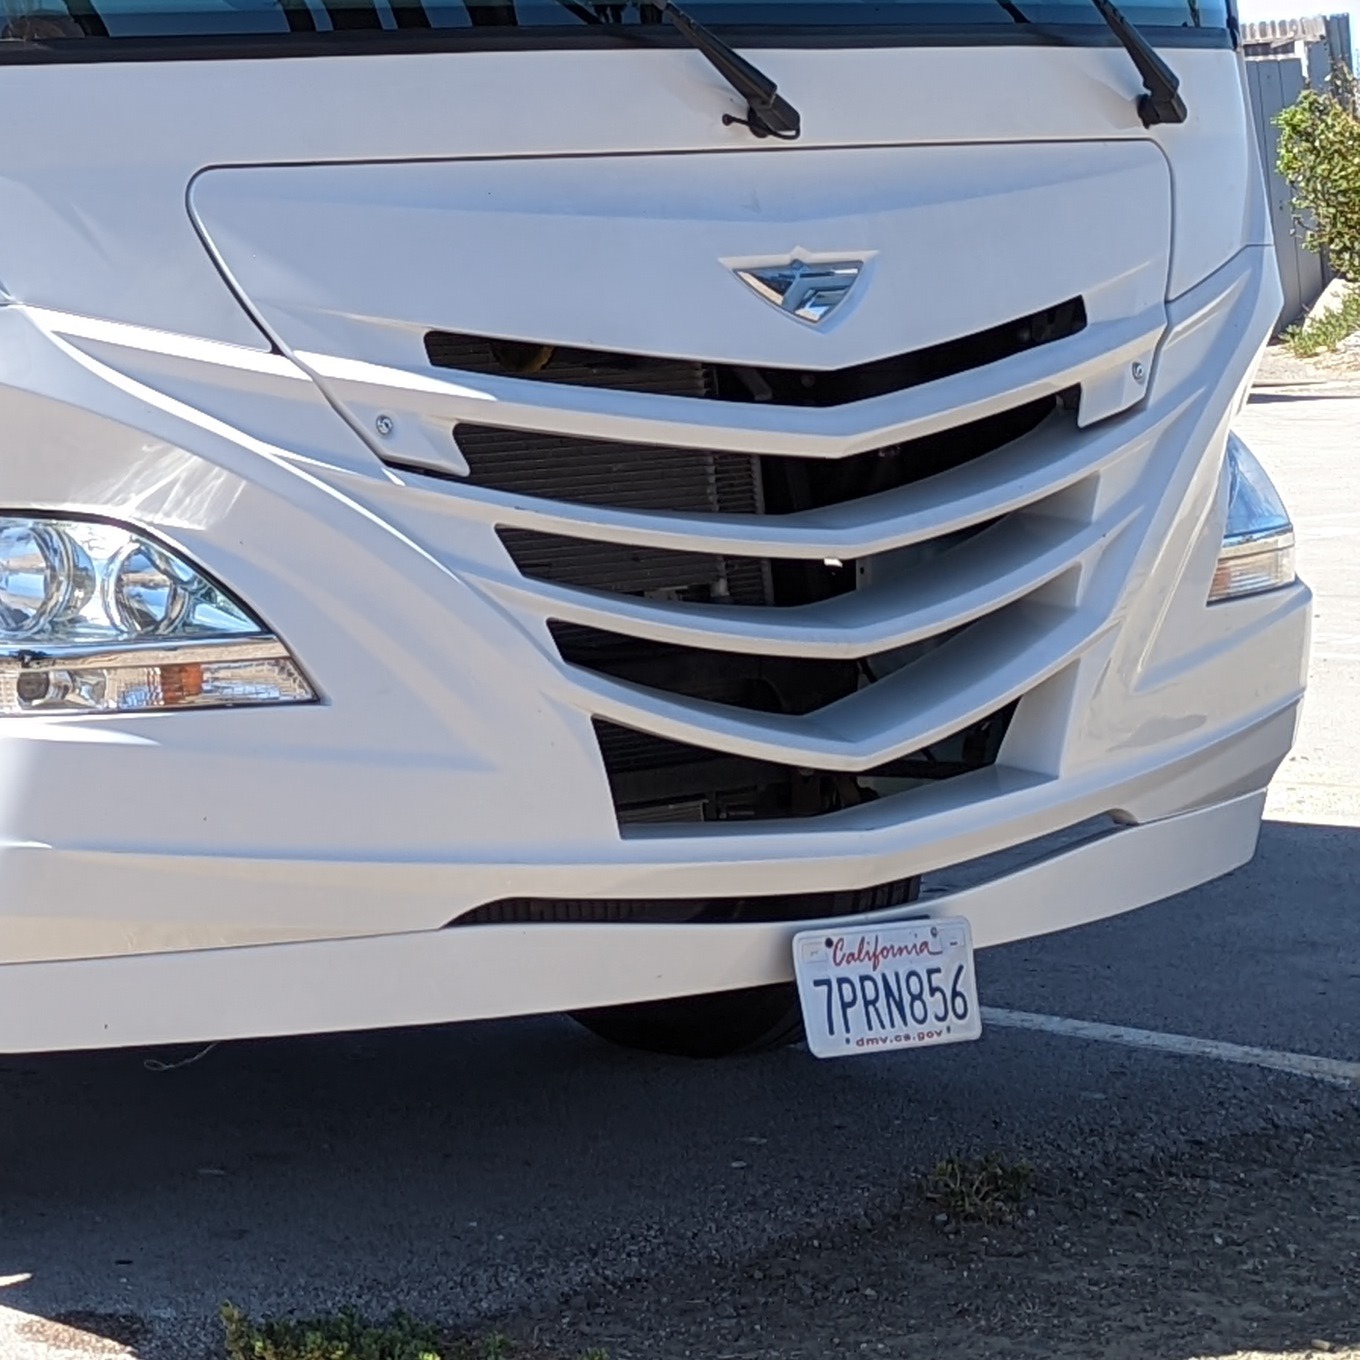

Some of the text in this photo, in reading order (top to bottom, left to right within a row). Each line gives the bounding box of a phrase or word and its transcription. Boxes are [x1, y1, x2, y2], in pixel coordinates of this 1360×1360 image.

[832, 934, 943, 972] California
[813, 964, 969, 1036] 7PRN856
[855, 1030, 943, 1048] dmv.ca.gov
